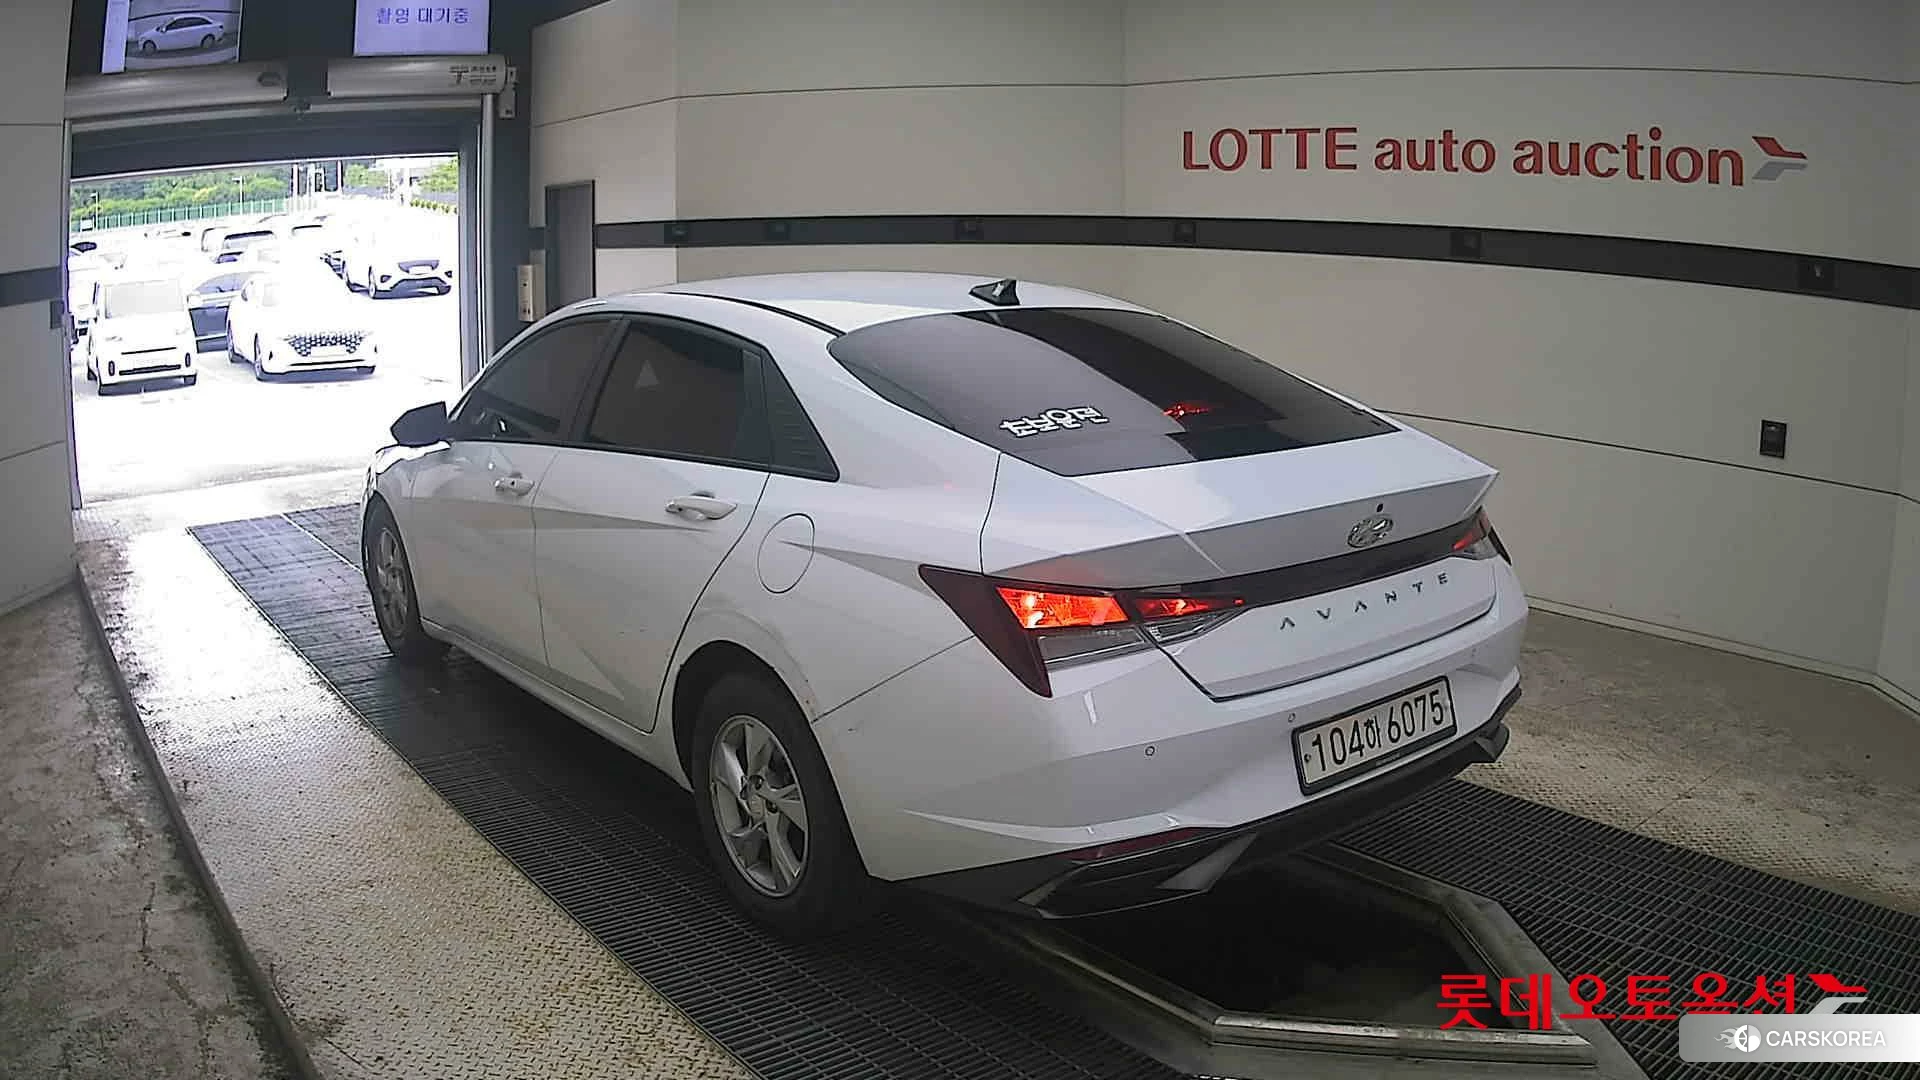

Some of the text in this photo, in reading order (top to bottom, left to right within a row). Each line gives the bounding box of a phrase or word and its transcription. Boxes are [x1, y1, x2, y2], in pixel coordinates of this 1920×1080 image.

[417, 7, 469, 24] 대기중
[1183, 127, 1744, 186] LOTTE auto auction
[1000, 406, 1109, 437] 초보운전
[1279, 572, 1449, 631] AVANTE
